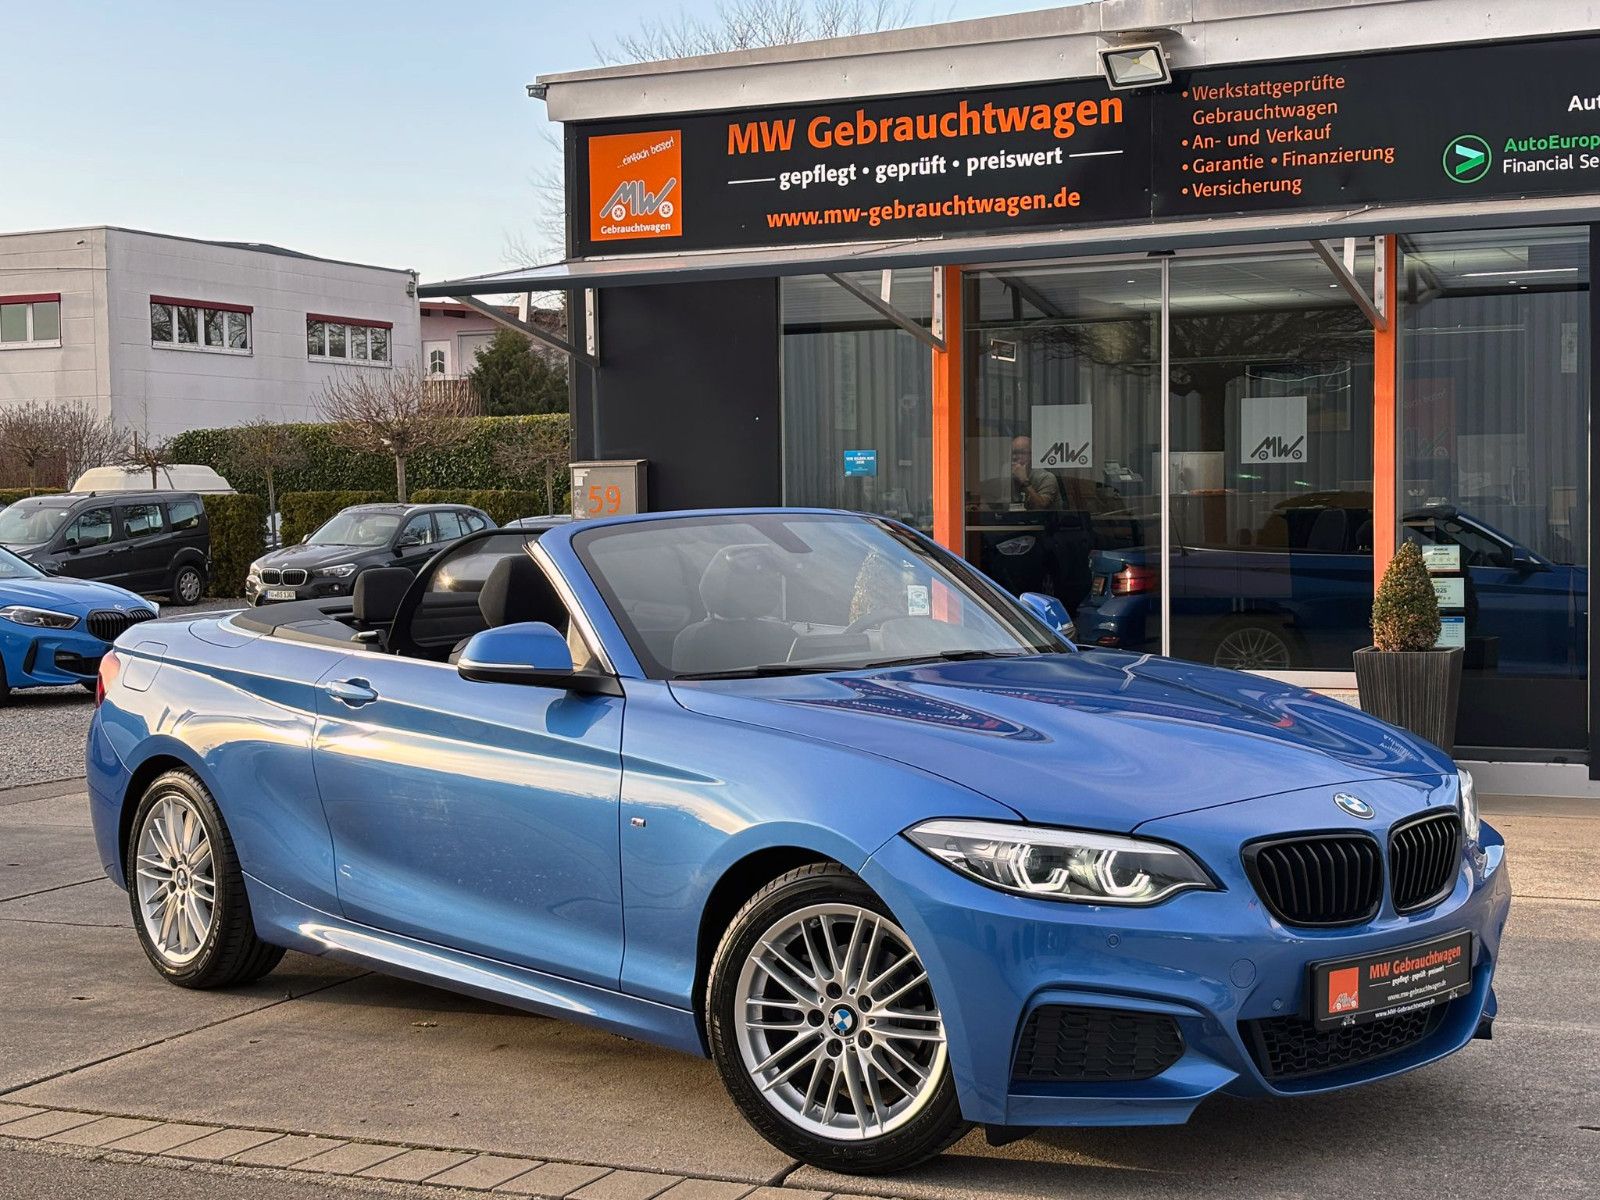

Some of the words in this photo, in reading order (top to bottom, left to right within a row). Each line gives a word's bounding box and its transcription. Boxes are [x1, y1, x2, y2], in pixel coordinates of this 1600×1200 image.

[1192, 74, 1345, 100] Werkstattgeprüfte
[728, 118, 796, 155] MW
[807, 97, 1123, 149] Gebrauchtwagen
[1192, 102, 1338, 126] Gebrauchtwagen
[650, 136, 674, 154] besser!
[1192, 134, 1221, 149] An-
[1227, 128, 1260, 147] und
[1266, 123, 1332, 143] Verkauf
[779, 163, 857, 191] gepflegt
[875, 155, 947, 184] geprüft
[967, 147, 1063, 177] preiswert
[1192, 153, 1264, 174] Garantie
[1282, 147, 1395, 168] Finanzierung
[1503, 154, 1574, 174] Financial
[1579, 154, 1600, 169] Se
[600, 177, 677, 219] MW
[1192, 177, 1302, 198] Versicherung
[767, 186, 1081, 227] www.mw-gebrauchtwagen.de
[601, 223, 671, 235] Gebrauchtwagen
[589, 486, 621, 513] 59
[1369, 962, 1391, 979] MW
[1393, 944, 1462, 973] Gebrauchtwagen
